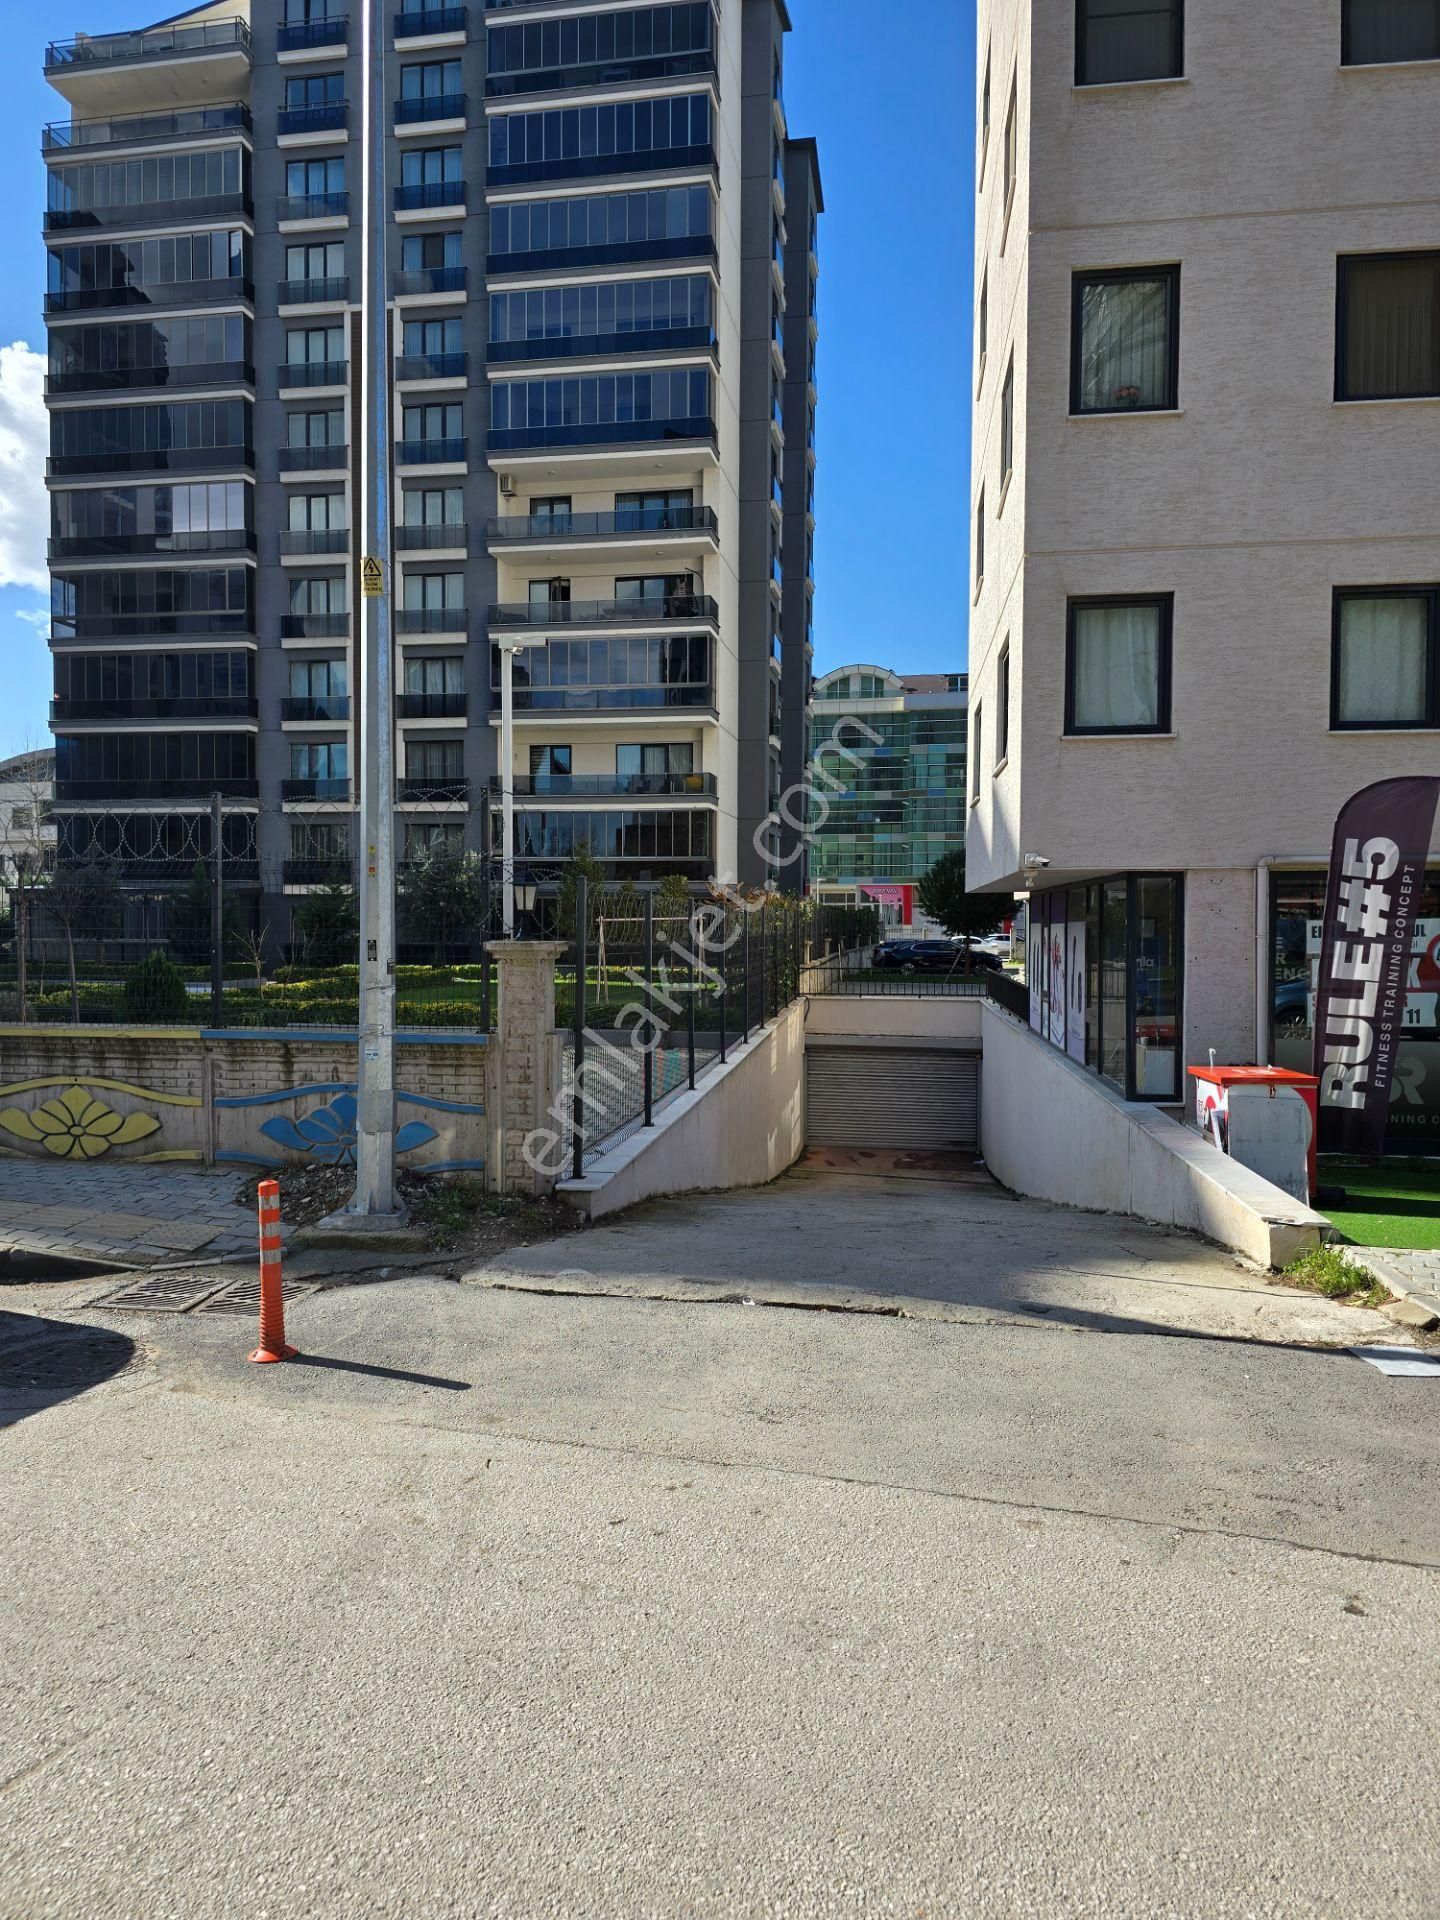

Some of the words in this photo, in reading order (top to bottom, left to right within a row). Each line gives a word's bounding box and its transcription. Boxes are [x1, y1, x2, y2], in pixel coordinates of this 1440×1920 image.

[1394, 865, 1415, 939] CONCEPT
[1320, 837, 1400, 1110] RULE#5
[1383, 943, 1402, 1017] TRAINING
[1375, 1022, 1392, 1088] FITNESS
